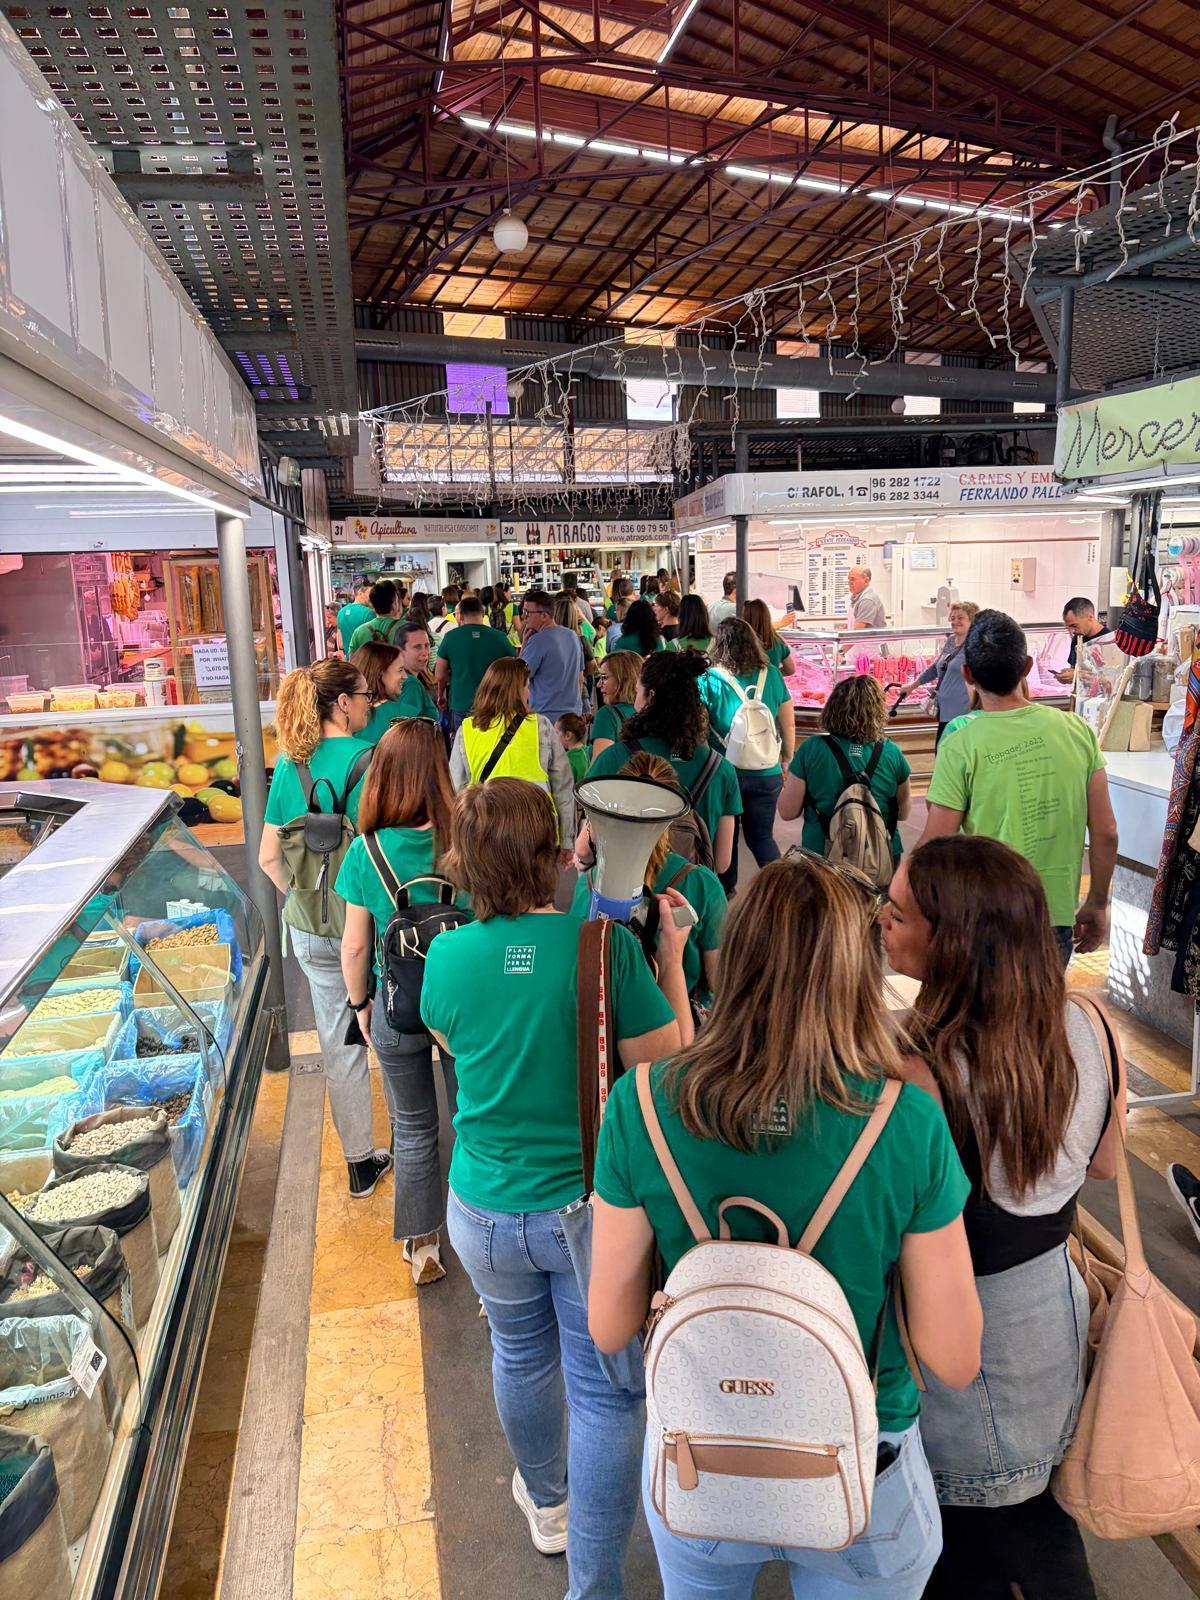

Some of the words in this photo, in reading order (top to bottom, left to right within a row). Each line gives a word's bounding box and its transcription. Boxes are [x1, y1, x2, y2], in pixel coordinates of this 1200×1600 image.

[872, 478, 886, 488] 96
[889, 477, 910, 487] 282
[913, 476, 941, 487] 1722
[959, 472, 1012, 486] CARNES
[1017, 472, 1026, 484] Y
[787, 487, 798, 499] C/
[802, 486, 845, 498] RAFOL,
[848, 485, 854, 497] 1
[872, 492, 886, 501] 96
[889, 491, 910, 501] 282
[913, 490, 940, 500] 3344
[960, 486, 1028, 501] FERRANDO
[334, 525, 344, 536] 31
[503, 526, 514, 535] 30
[547, 522, 601, 545] ATRAGOS
[606, 525, 619, 534] Tlf.
[620, 524, 635, 533] 636
[636, 524, 646, 533] 09
[648, 523, 660, 533] 79
[660, 523, 668, 532] 50
[606, 533, 670, 543] www.atragos.com
[719, 1379, 775, 1396] GUESS
